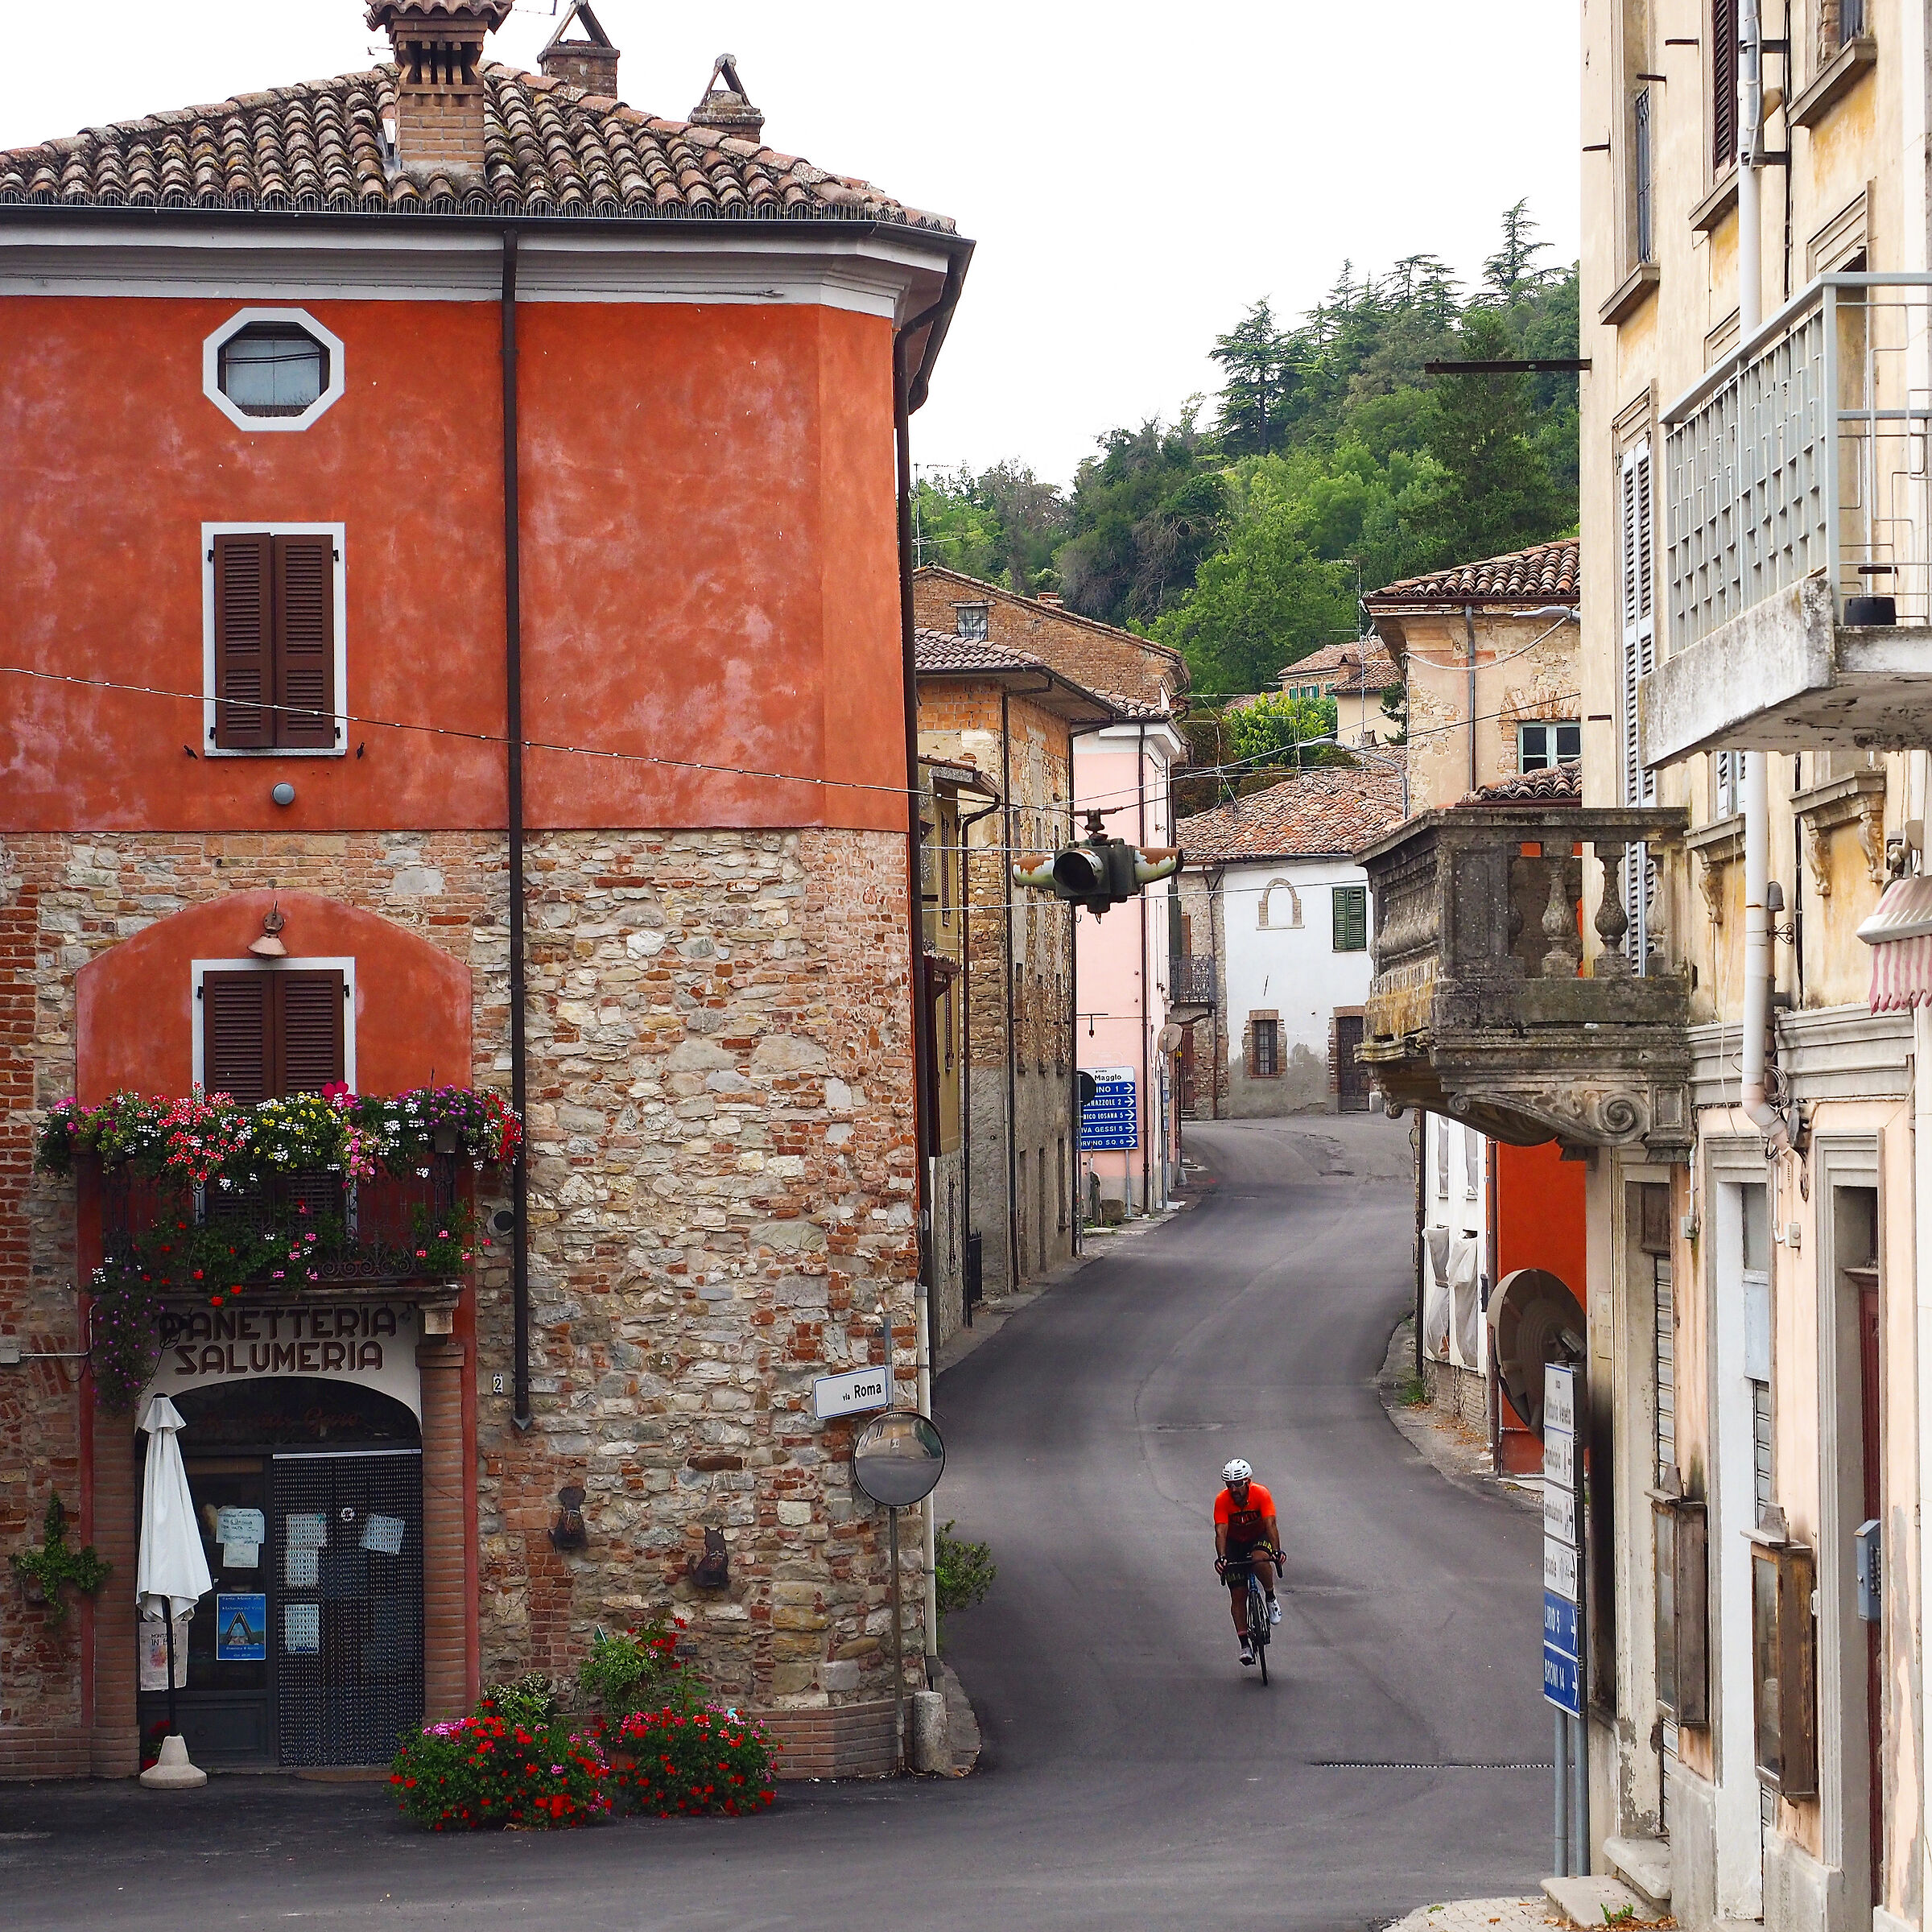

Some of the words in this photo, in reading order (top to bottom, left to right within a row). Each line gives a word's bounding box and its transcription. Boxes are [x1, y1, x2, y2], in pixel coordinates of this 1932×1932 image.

[174, 1340, 383, 1375] SALUMERIA
[494, 1378, 502, 1390] 2
[854, 1383, 882, 1398] Roma
[1557, 1609, 1560, 1634] 5
